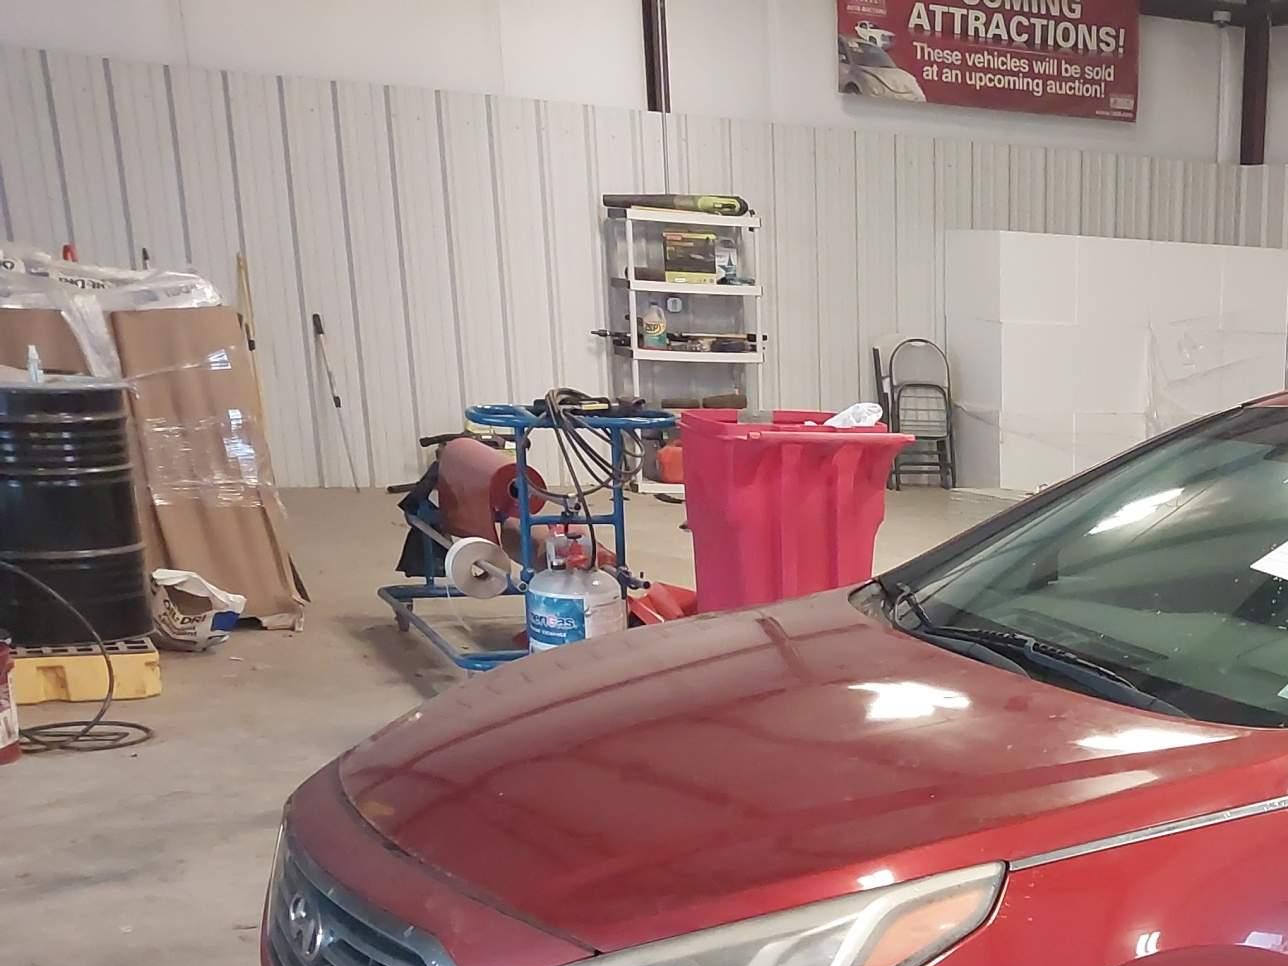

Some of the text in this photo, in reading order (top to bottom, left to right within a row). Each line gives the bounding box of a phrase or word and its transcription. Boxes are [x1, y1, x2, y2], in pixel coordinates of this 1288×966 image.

[908, 2, 1125, 53] ATTRACTIONS!
[962, 0, 1082, 19] ING
[913, 42, 1114, 81] These vehicles will be sold
[923, 64, 1105, 98] at an upcoming auction!
